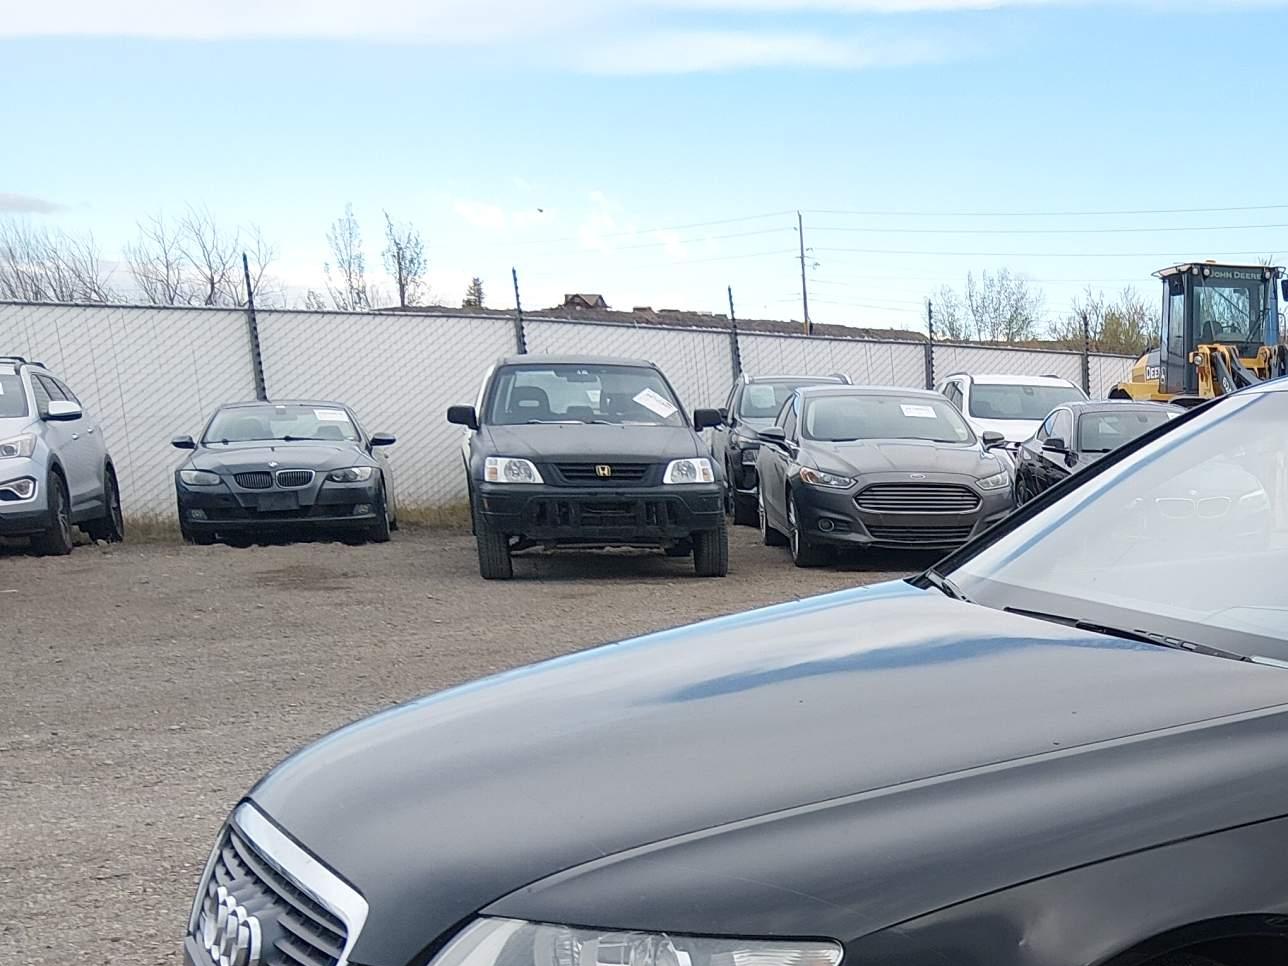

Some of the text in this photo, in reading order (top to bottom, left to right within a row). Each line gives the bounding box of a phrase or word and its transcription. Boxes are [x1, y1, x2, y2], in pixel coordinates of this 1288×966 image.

[1210, 270, 1262, 280] JOHN DEERE
[1146, 366, 1160, 380] DEE
